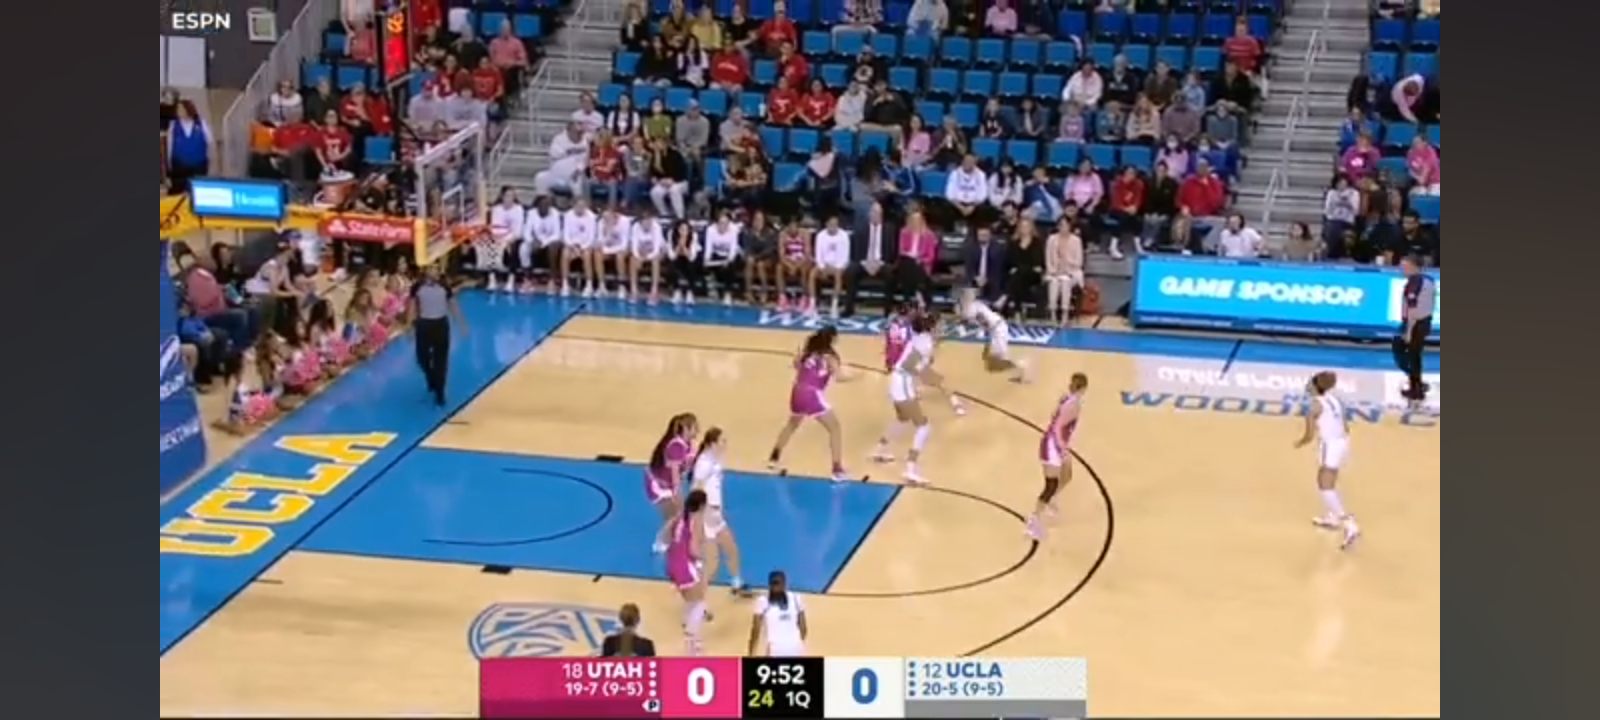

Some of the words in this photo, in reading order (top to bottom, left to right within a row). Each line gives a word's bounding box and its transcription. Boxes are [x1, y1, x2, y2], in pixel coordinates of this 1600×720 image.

[1159, 276, 1235, 299] GAME
[1237, 280, 1364, 307] SPONSOR
[160, 431, 398, 557] UCLA
